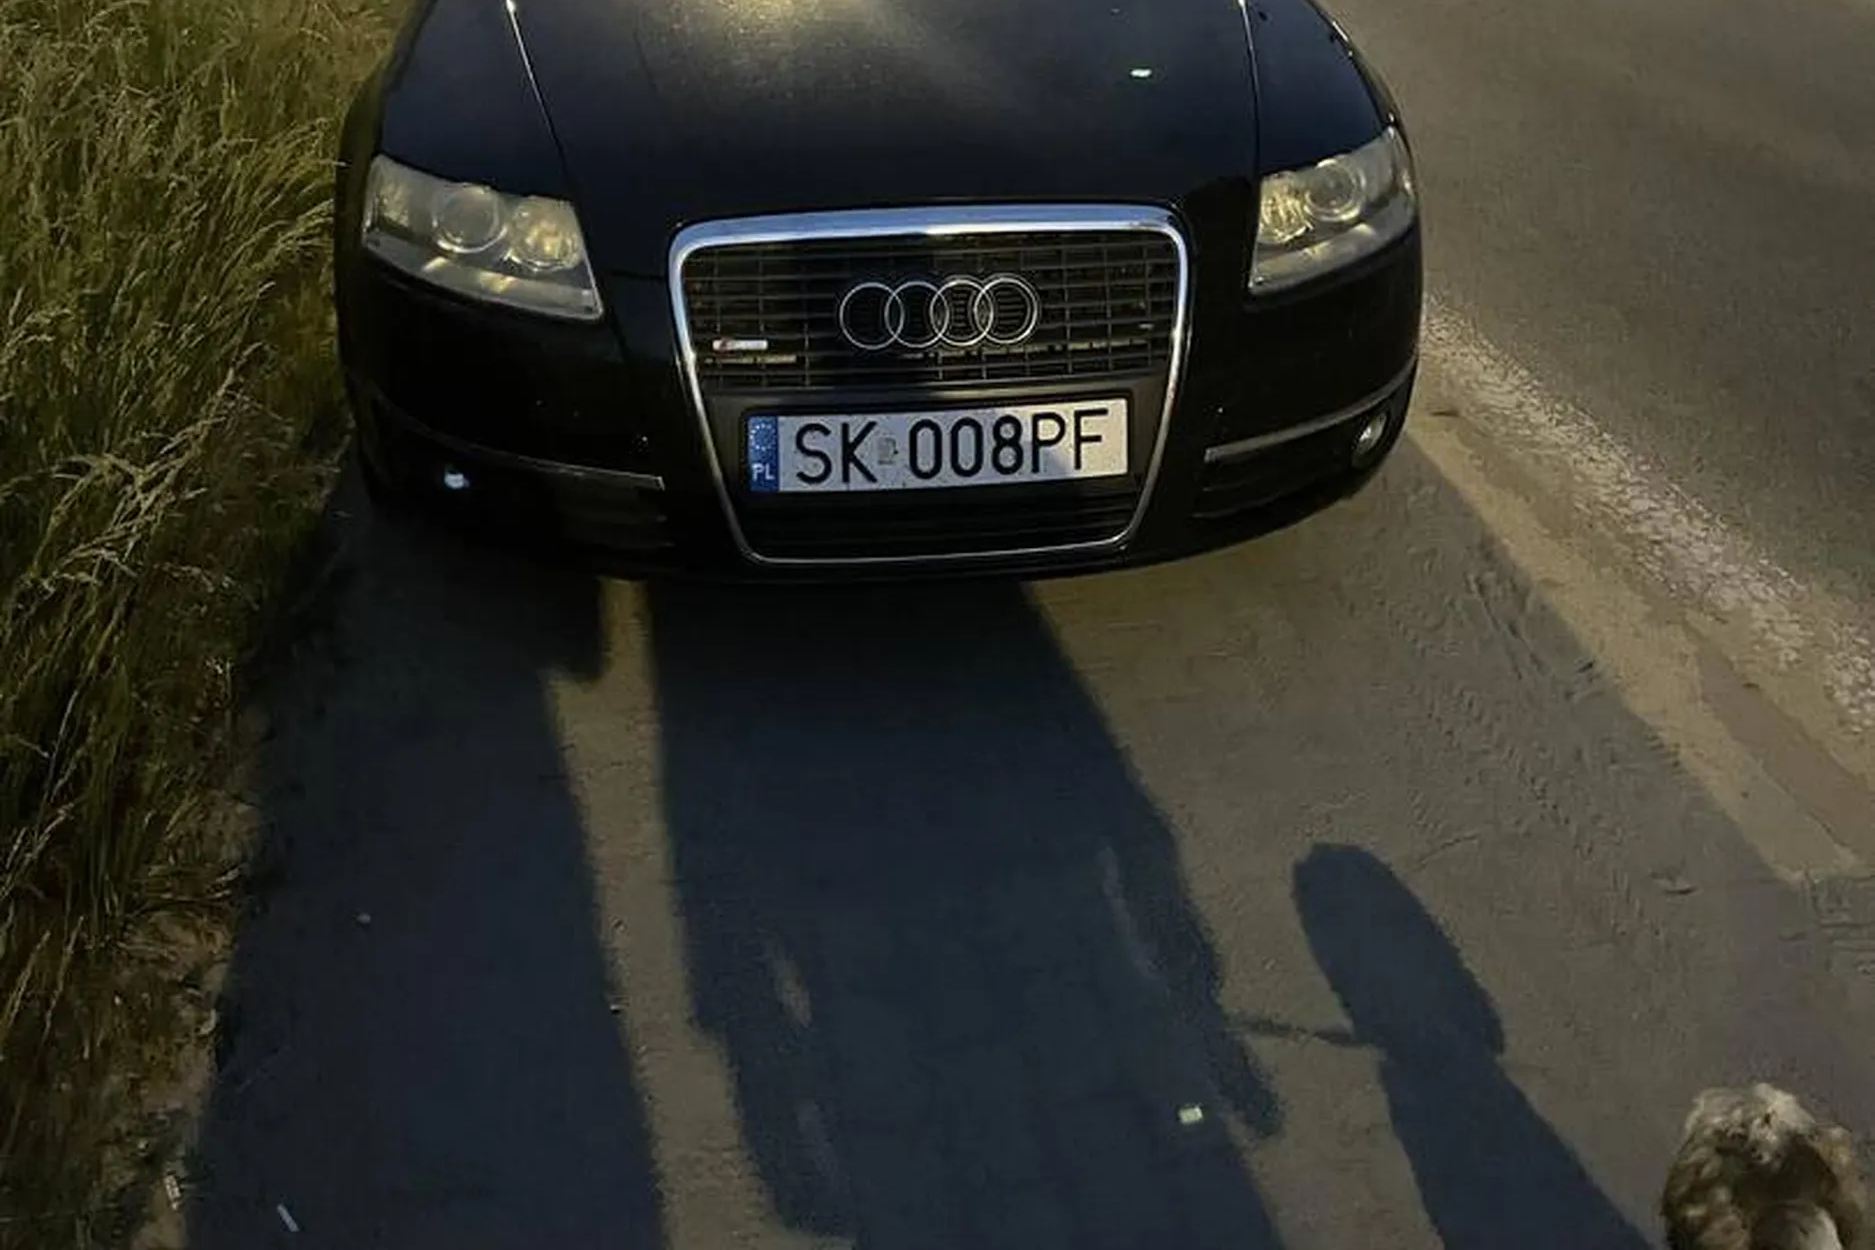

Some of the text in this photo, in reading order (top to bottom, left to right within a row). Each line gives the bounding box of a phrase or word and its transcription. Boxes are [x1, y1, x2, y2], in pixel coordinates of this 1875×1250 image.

[796, 408, 1108, 485] SK 008PF
[752, 463, 775, 482] PL
